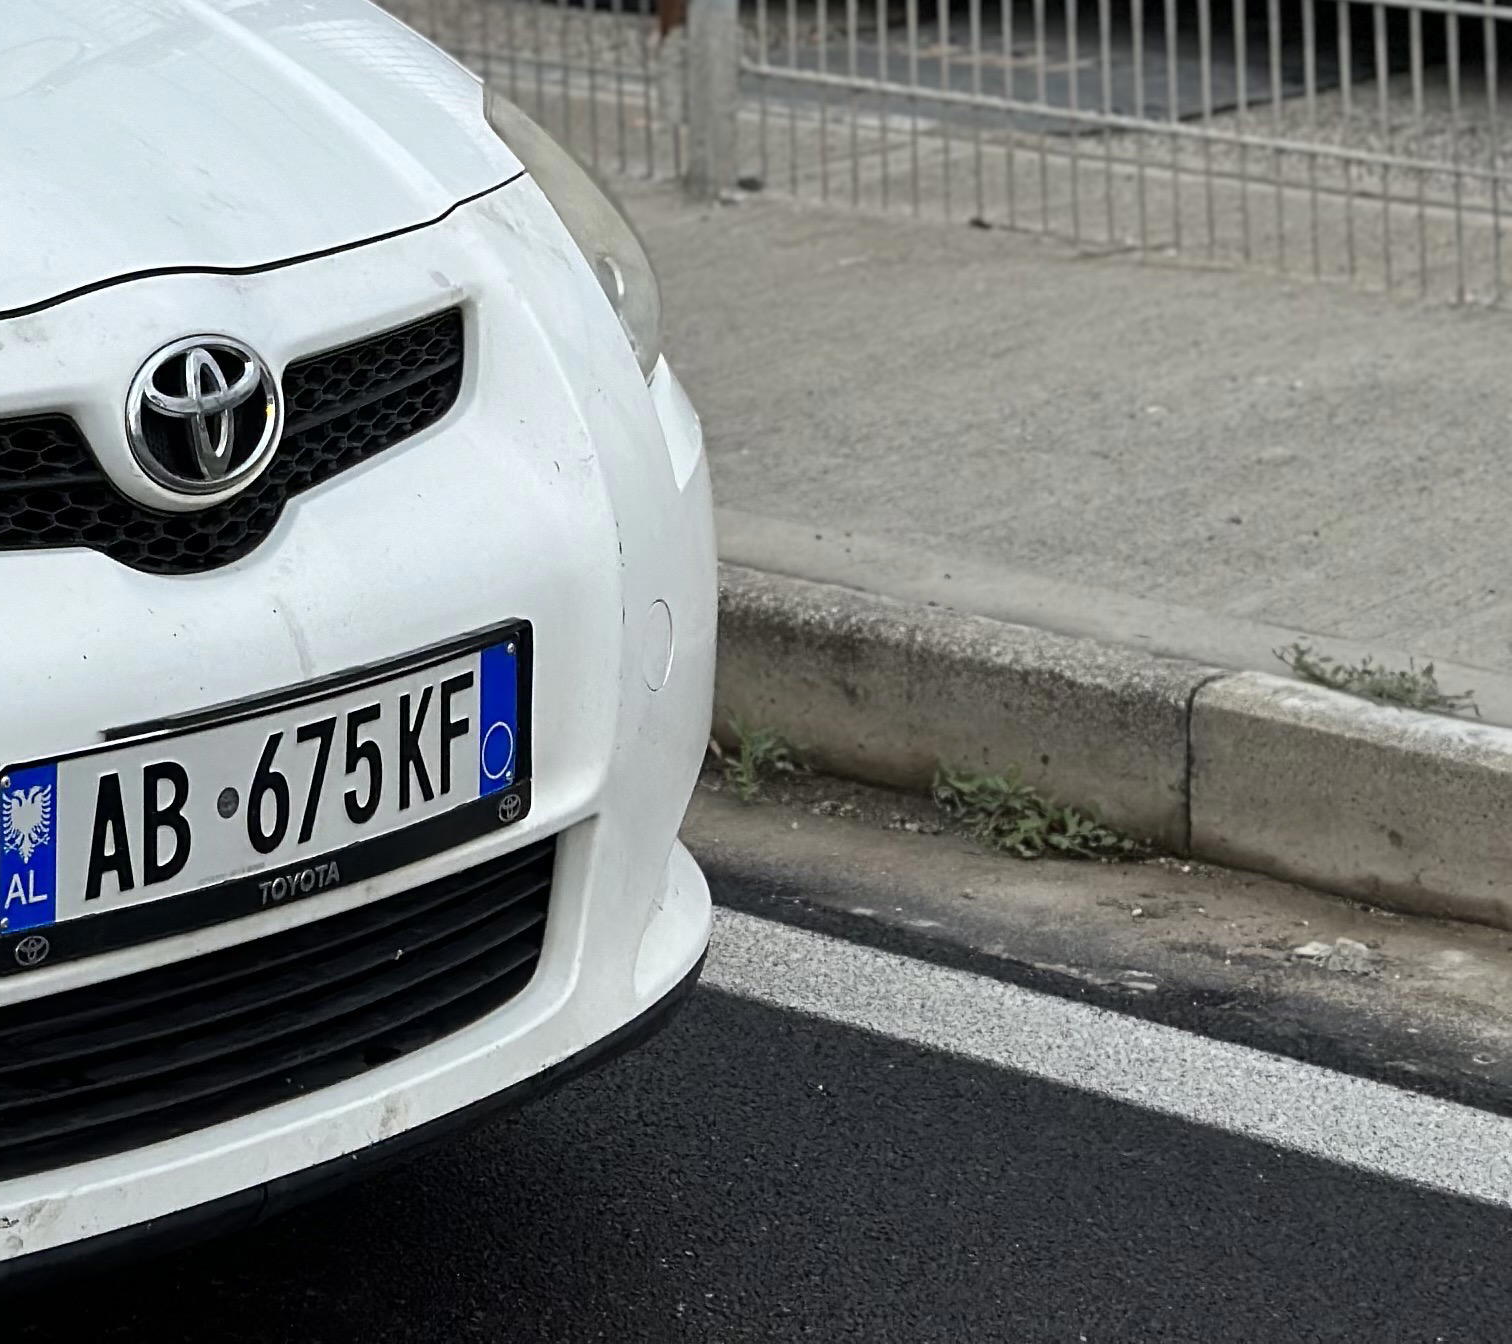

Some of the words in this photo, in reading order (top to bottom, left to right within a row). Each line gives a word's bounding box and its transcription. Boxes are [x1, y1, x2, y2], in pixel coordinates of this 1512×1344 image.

[85, 761, 191, 900] AB
[4, 870, 48, 909] AL
[258, 860, 341, 905] TOYOTA
